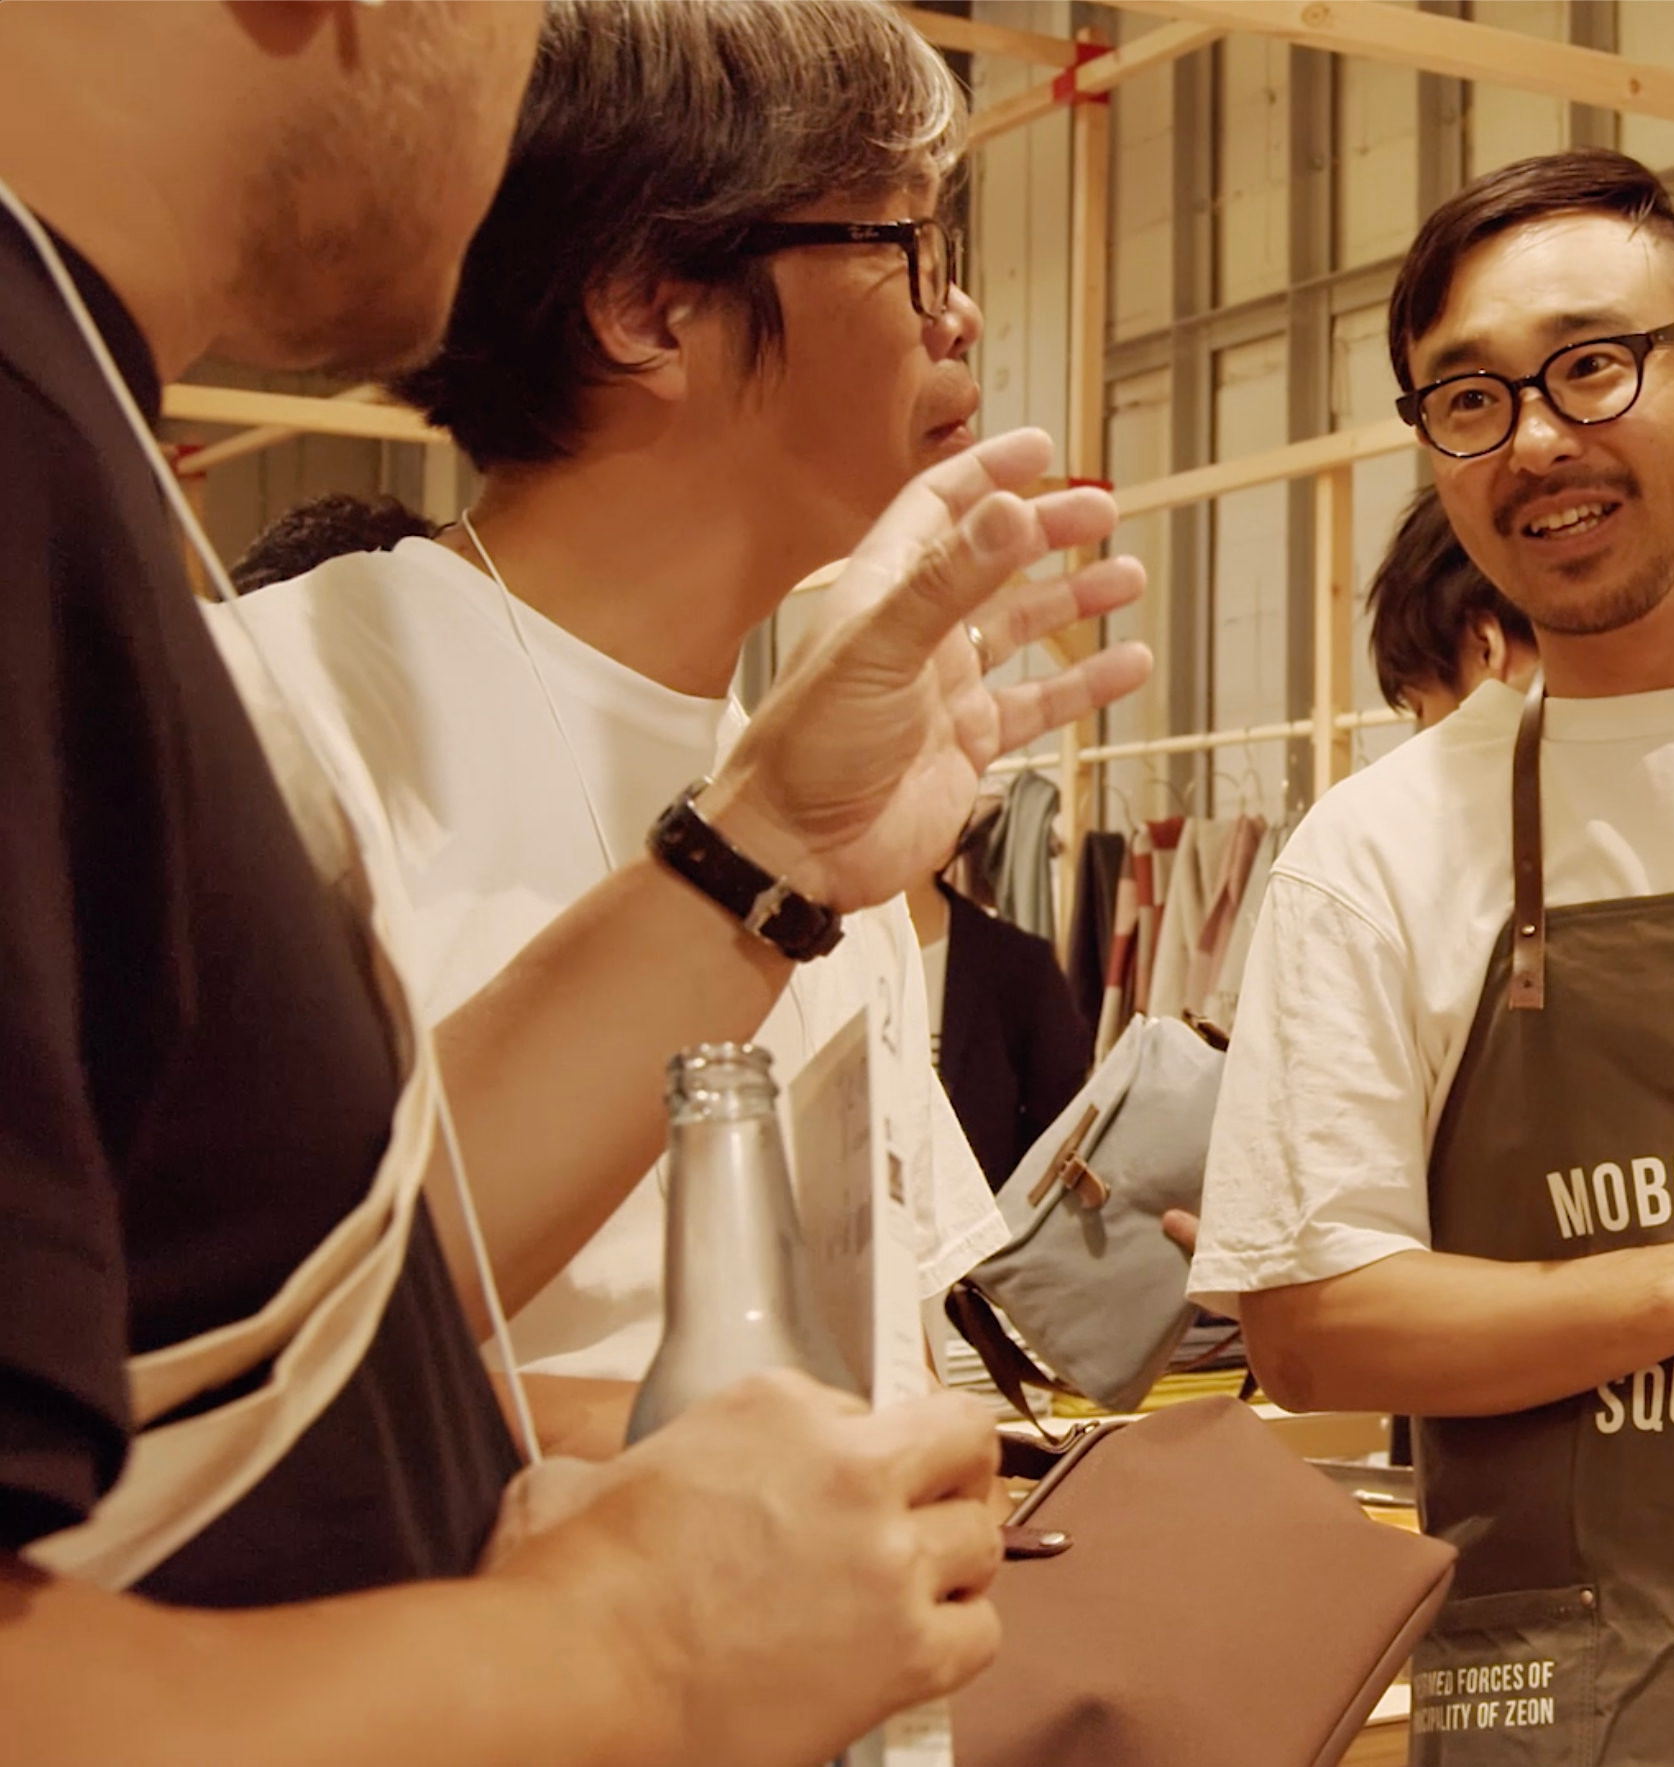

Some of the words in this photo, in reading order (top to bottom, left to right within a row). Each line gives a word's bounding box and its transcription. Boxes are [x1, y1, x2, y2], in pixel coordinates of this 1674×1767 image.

[1457, 1663, 1524, 1694] FORCES
[1528, 1661, 1555, 1689] OF
[1477, 1702, 1500, 1729] OF
[1504, 1697, 1554, 1727] ZEON
